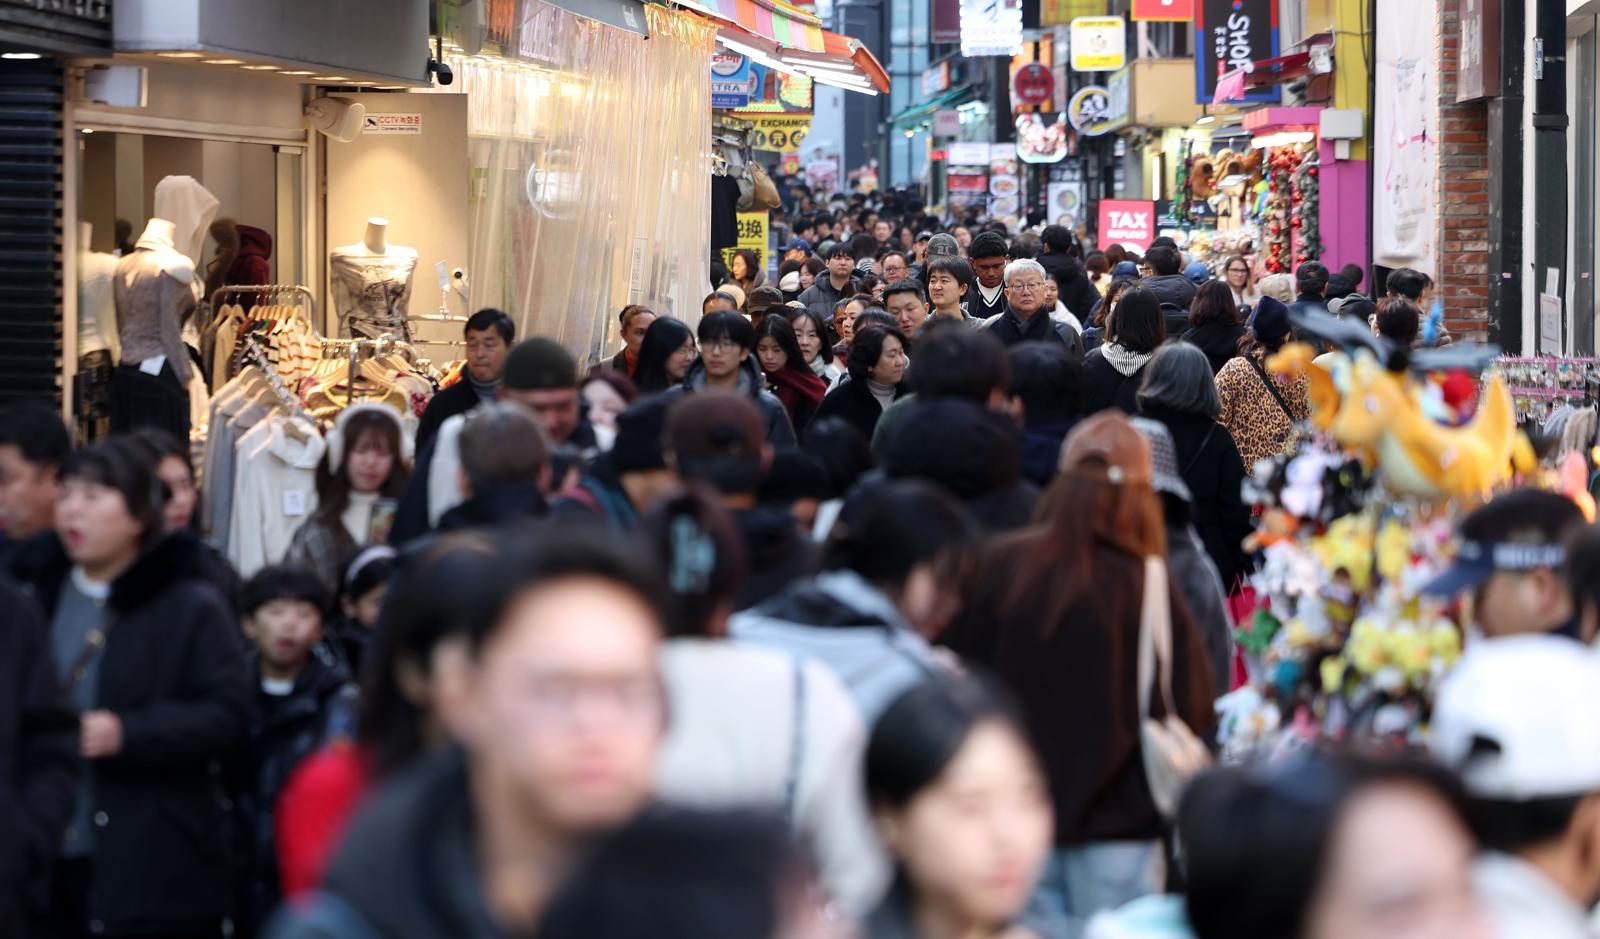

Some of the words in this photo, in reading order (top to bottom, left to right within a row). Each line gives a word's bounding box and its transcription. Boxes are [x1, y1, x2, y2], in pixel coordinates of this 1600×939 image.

[1227, 13, 1254, 73] SHOP
[760, 119, 810, 128] EXCHANGE
[1108, 212, 1148, 229] TAX
[1106, 229, 1148, 240] REFUND
